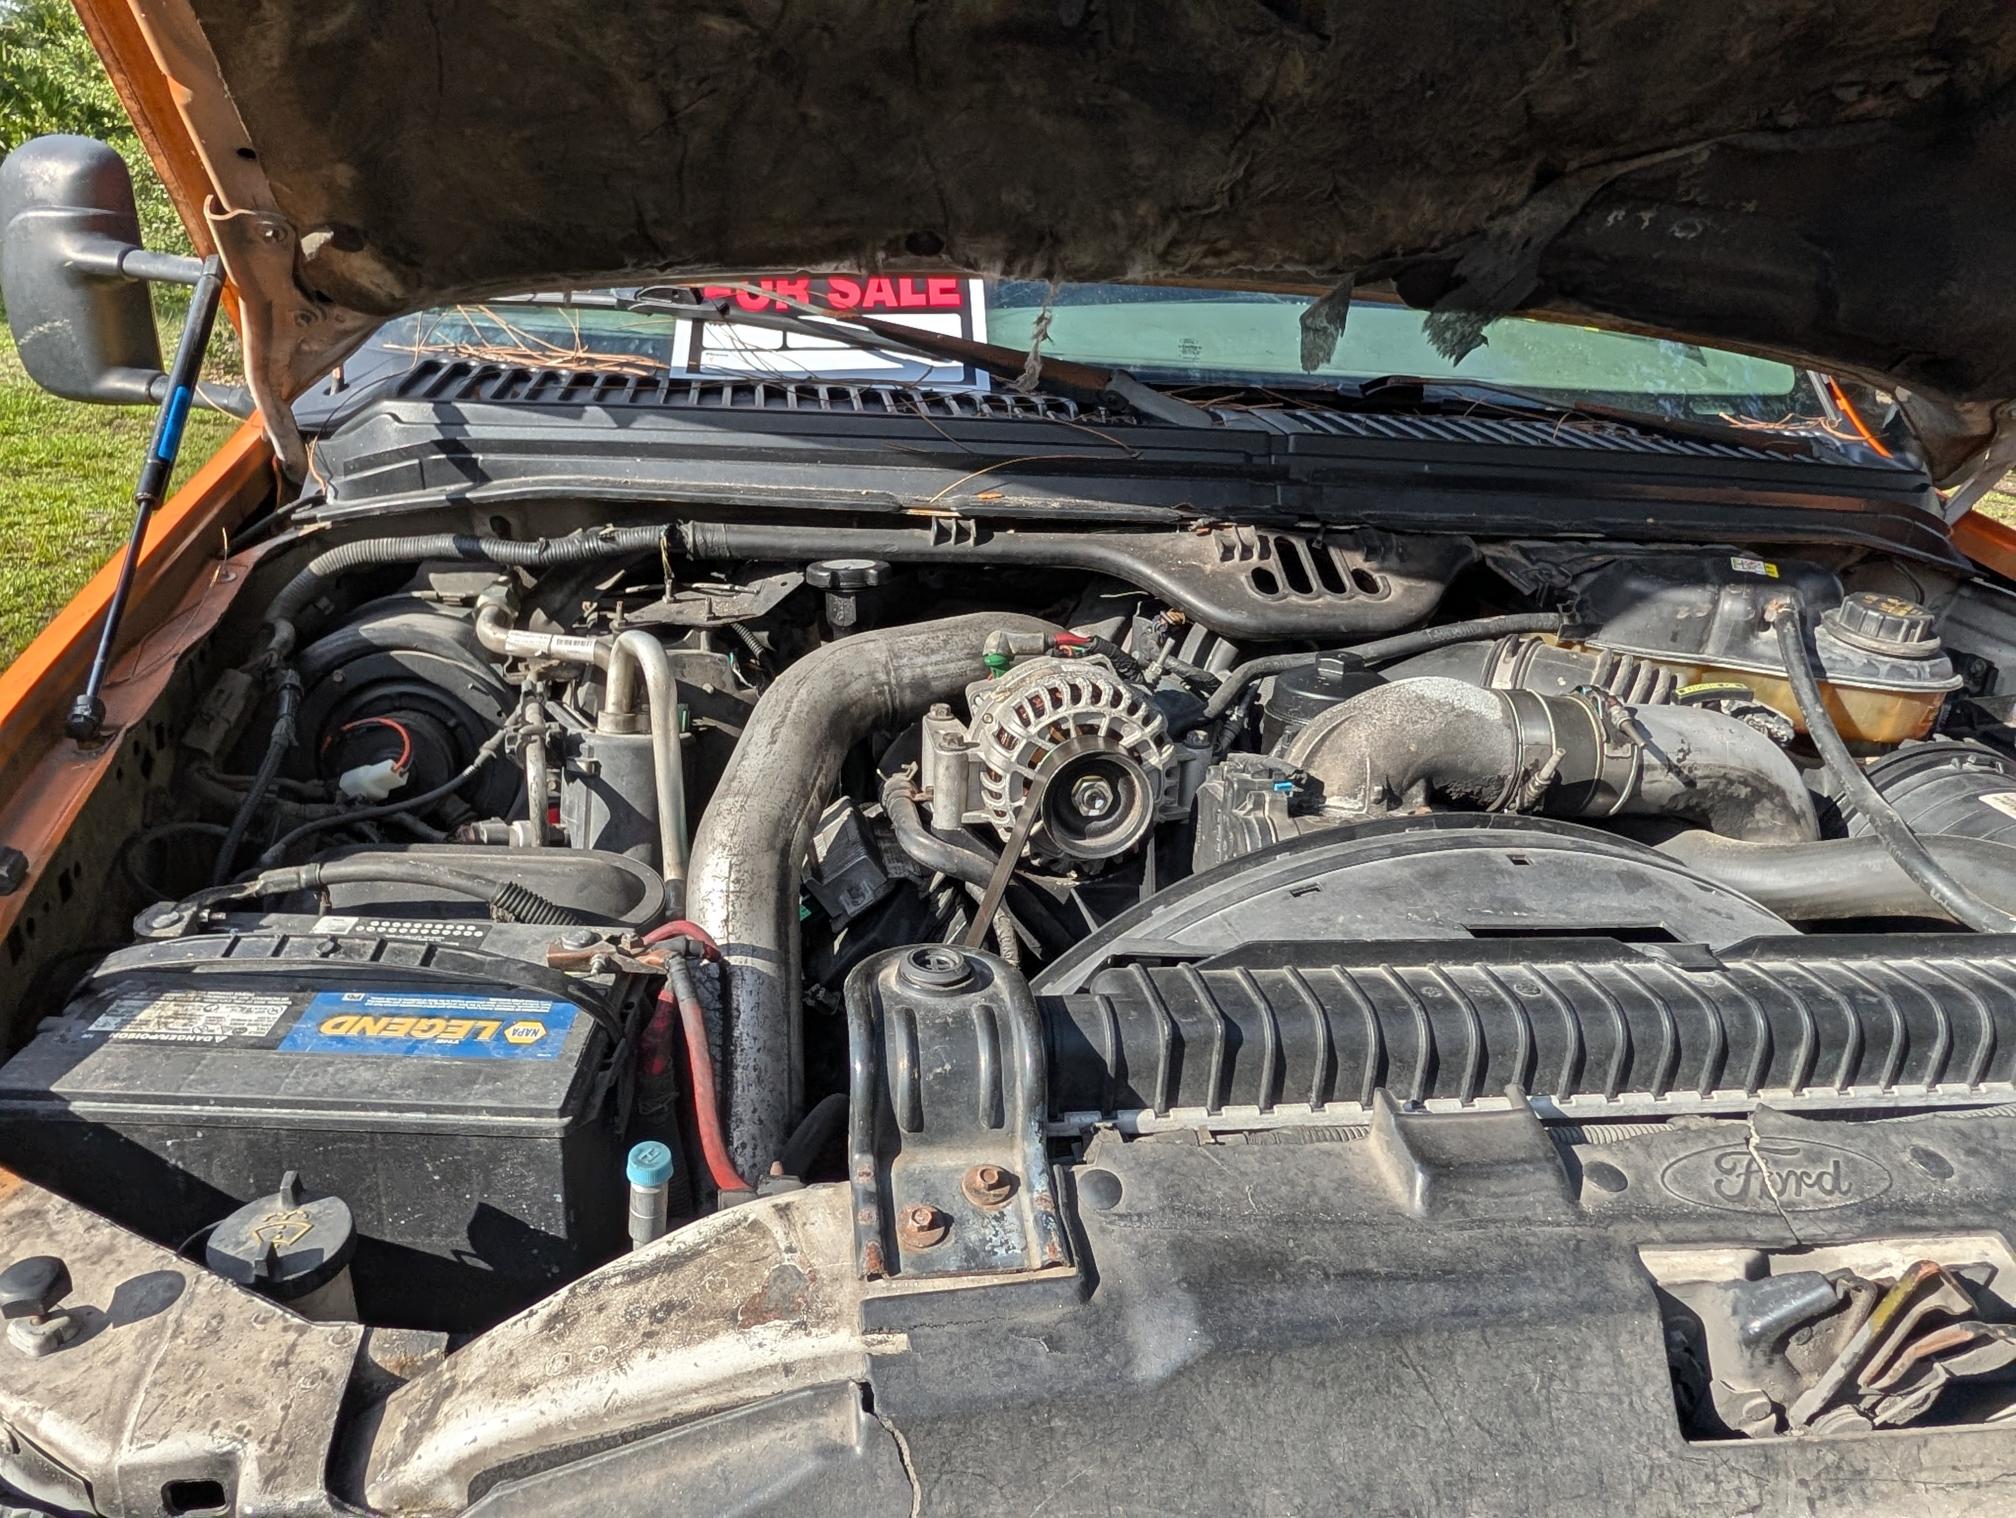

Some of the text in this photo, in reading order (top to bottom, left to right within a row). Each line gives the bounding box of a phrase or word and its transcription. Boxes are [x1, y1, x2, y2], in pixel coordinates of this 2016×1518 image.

[827, 277, 962, 309] SALE
[318, 1014, 506, 1041] LEGEND
[510, 1026, 541, 1038] NAPA
[1711, 1146, 1853, 1203] Ford
